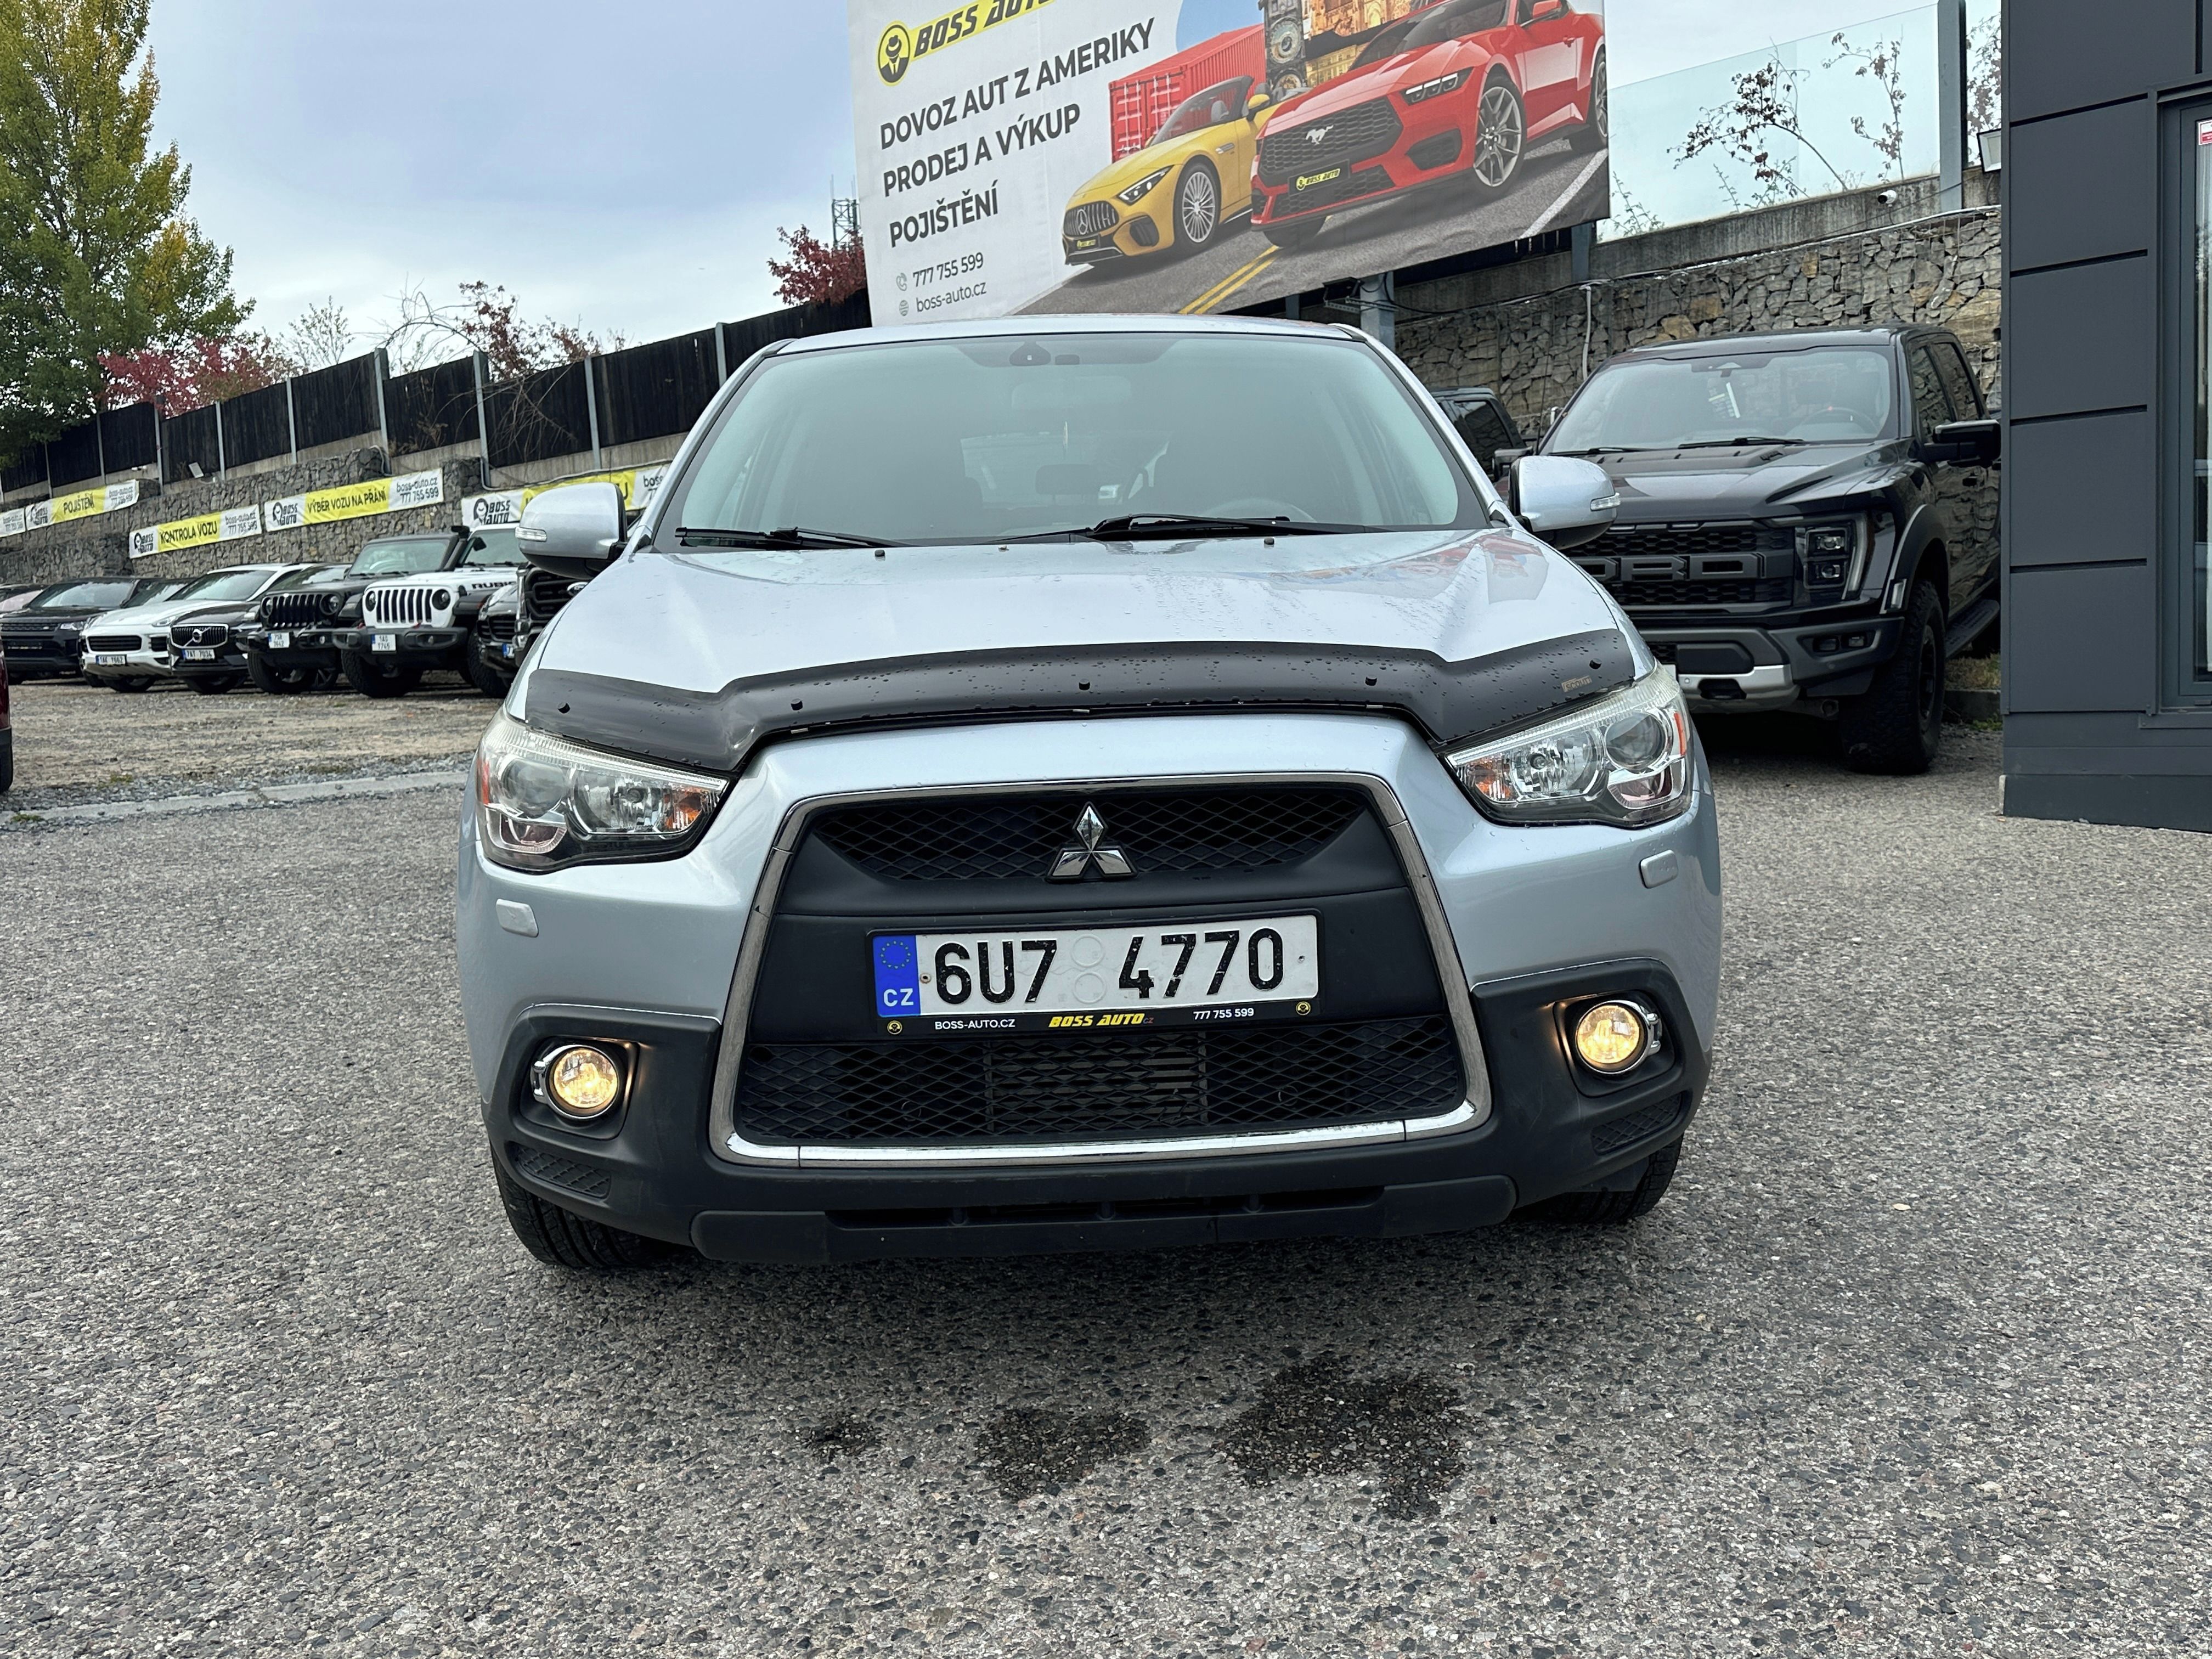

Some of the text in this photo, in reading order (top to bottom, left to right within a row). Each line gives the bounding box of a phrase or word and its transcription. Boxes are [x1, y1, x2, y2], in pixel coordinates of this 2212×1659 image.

[914, 0, 1050, 57] BOSS AU
[881, 17, 1155, 150] DOVOZ AUT Z AMERIKY
[884, 103, 1080, 198] PRODEJ A VÝKUP
[890, 179, 998, 248] POJIŠTĚNÍ
[913, 252, 984, 287] 777 755 599
[916, 282, 986, 312] boss-auto.cz
[330, 496, 351, 510] VOZU
[352, 494, 364, 507] NA
[364, 486, 387, 504] PŘÁNÍ
[400, 492, 411, 504] 777
[425, 486, 439, 499] 599
[489, 500, 511, 513] BOSS
[160, 520, 217, 545] KONTROLA VOZU
[934, 927, 1284, 1005] 6U7 4770
[883, 989, 915, 1007] CZ
[935, 1019, 1015, 1030] BOSS-AUTO.CZ
[1048, 1015, 1094, 1028] BOSS
[1096, 1013, 1146, 1026] AUTO
[1193, 1011, 1210, 1020] 777
[1213, 1009, 1233, 1019] 755
[1234, 1008, 1255, 1017] 599
